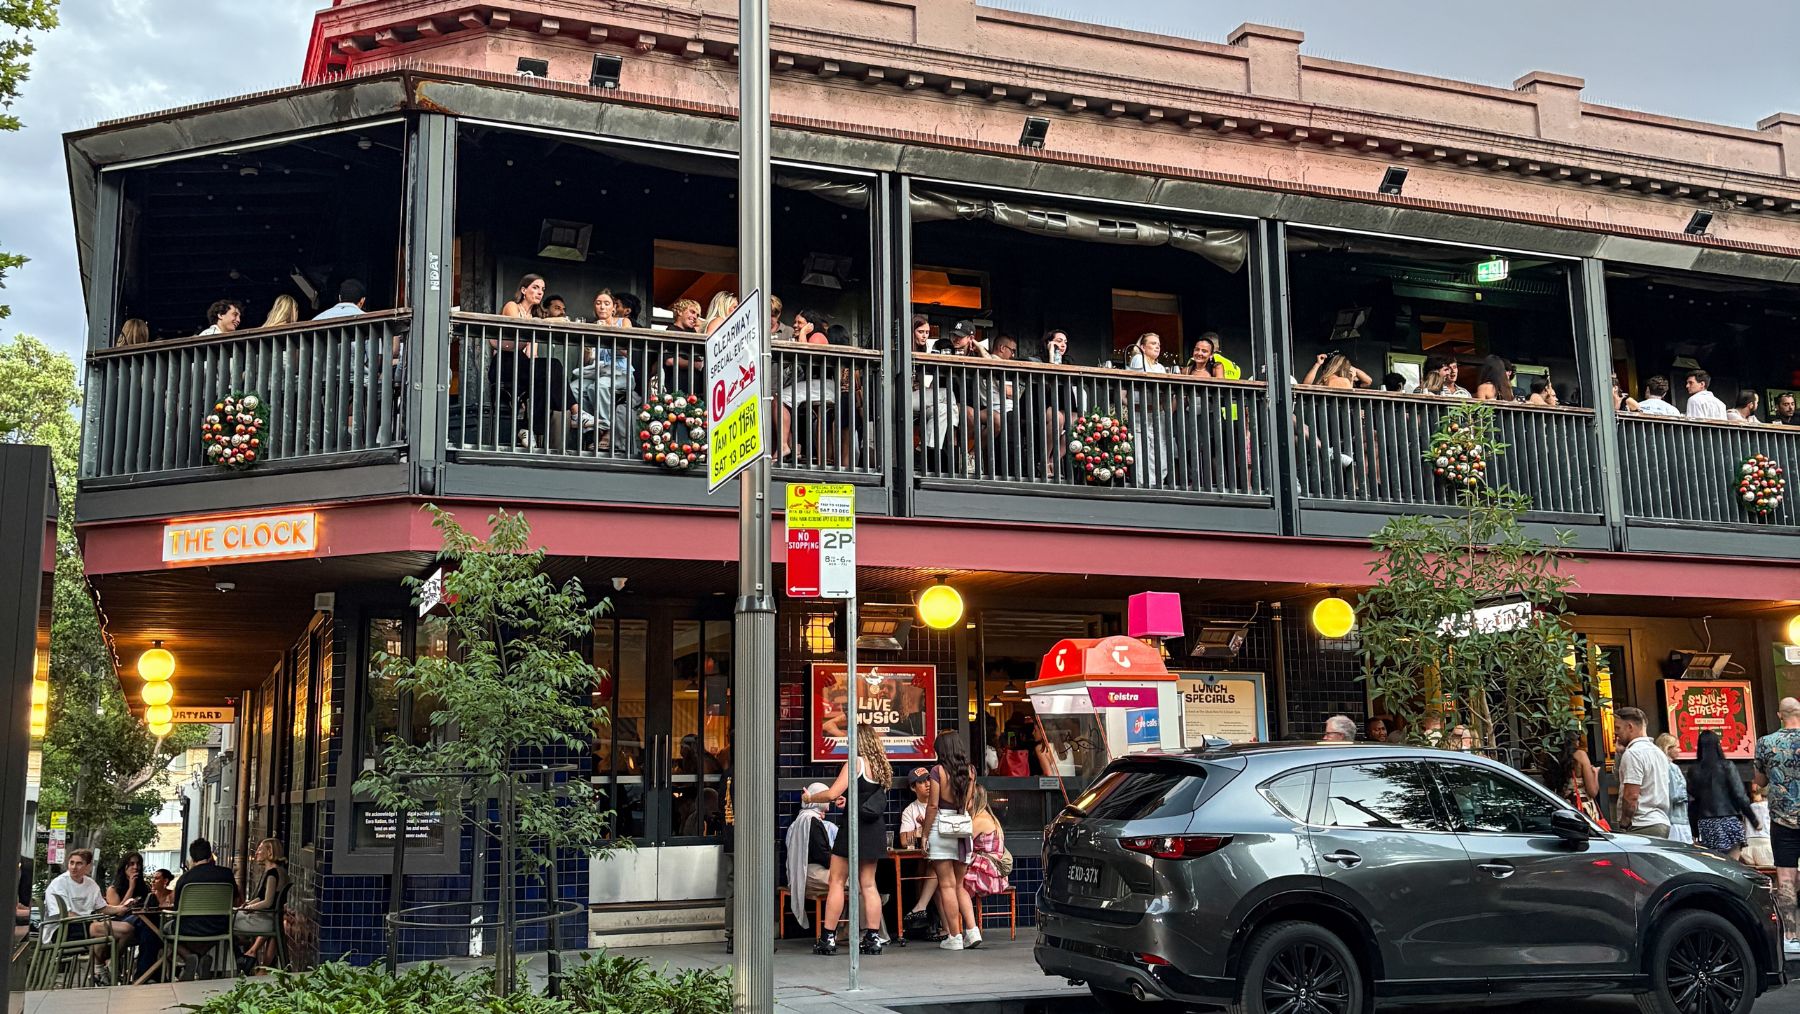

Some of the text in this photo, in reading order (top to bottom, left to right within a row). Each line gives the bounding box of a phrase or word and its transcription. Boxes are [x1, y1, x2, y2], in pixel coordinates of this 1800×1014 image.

[713, 309, 751, 357] CLEARWAY
[711, 327, 756, 379] SPECIAL EVENTS
[714, 430, 727, 455] 7AM
[729, 421, 738, 443] TO
[715, 435, 757, 477] SAT 13 DEC
[168, 519, 308, 556] THE CLOCK
[798, 532, 810, 542] NO
[823, 532, 853, 549] 2P
[788, 541, 819, 550] STOPPING
[1192, 683, 1228, 694] LUNCH
[1108, 691, 1139, 702] Telstra
[1688, 693, 1728, 706] SYDNEY
[1688, 704, 1729, 717] STREETS
[1146, 718, 1158, 728] calls
